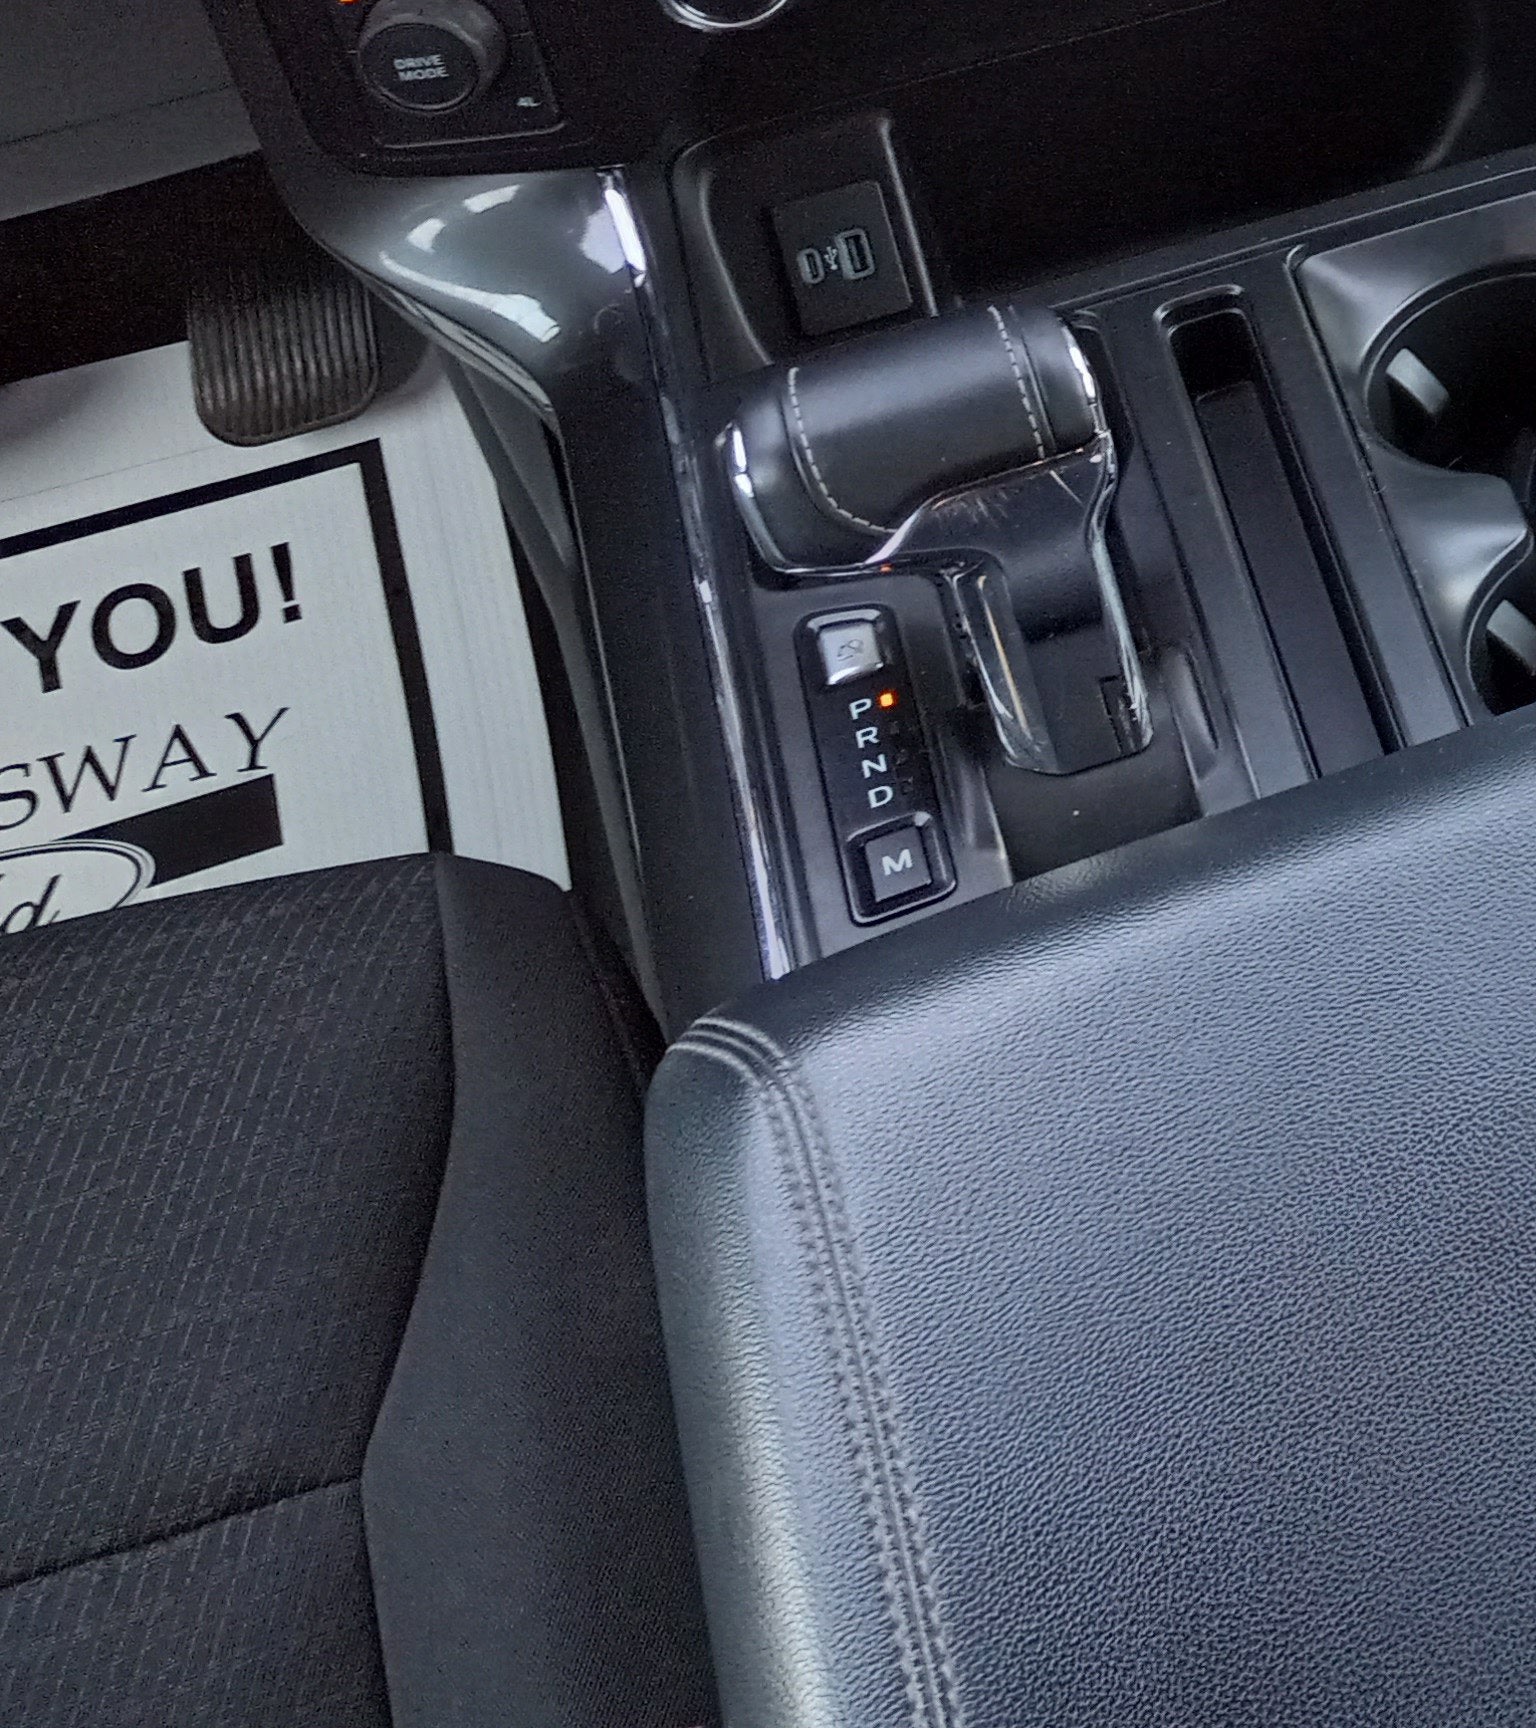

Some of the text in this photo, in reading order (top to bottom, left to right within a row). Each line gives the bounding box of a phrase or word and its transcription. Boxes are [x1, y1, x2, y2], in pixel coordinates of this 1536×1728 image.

[393, 53, 443, 71] DRIVE
[399, 66, 449, 82] MODE
[0, 541, 303, 694] YOU!
[848, 697, 874, 721] P
[855, 726, 880, 749] R
[861, 753, 889, 779] N
[867, 784, 894, 809] D
[881, 848, 914, 876] M
